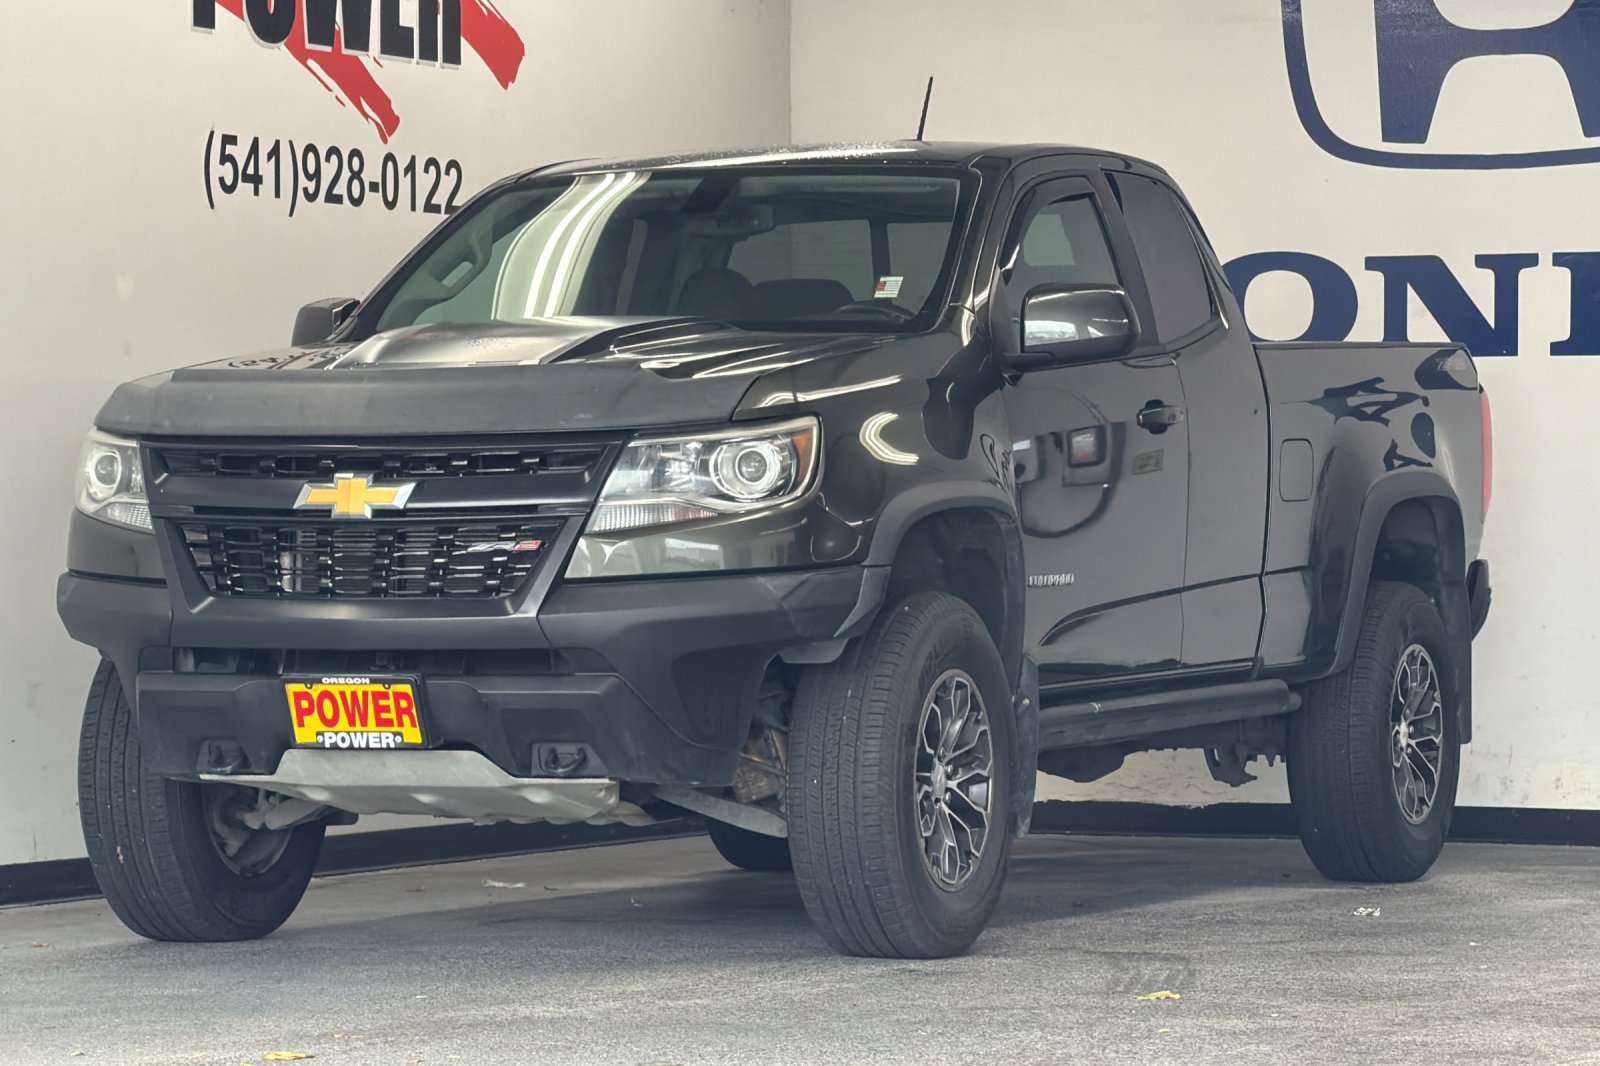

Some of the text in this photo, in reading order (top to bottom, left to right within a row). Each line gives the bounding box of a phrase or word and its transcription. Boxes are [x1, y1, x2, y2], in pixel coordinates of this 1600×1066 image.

[204, 130, 463, 217] (541)928-0122
[321, 677, 370, 685] OREGON
[293, 690, 418, 728] POWER
[323, 732, 396, 748] POWER
